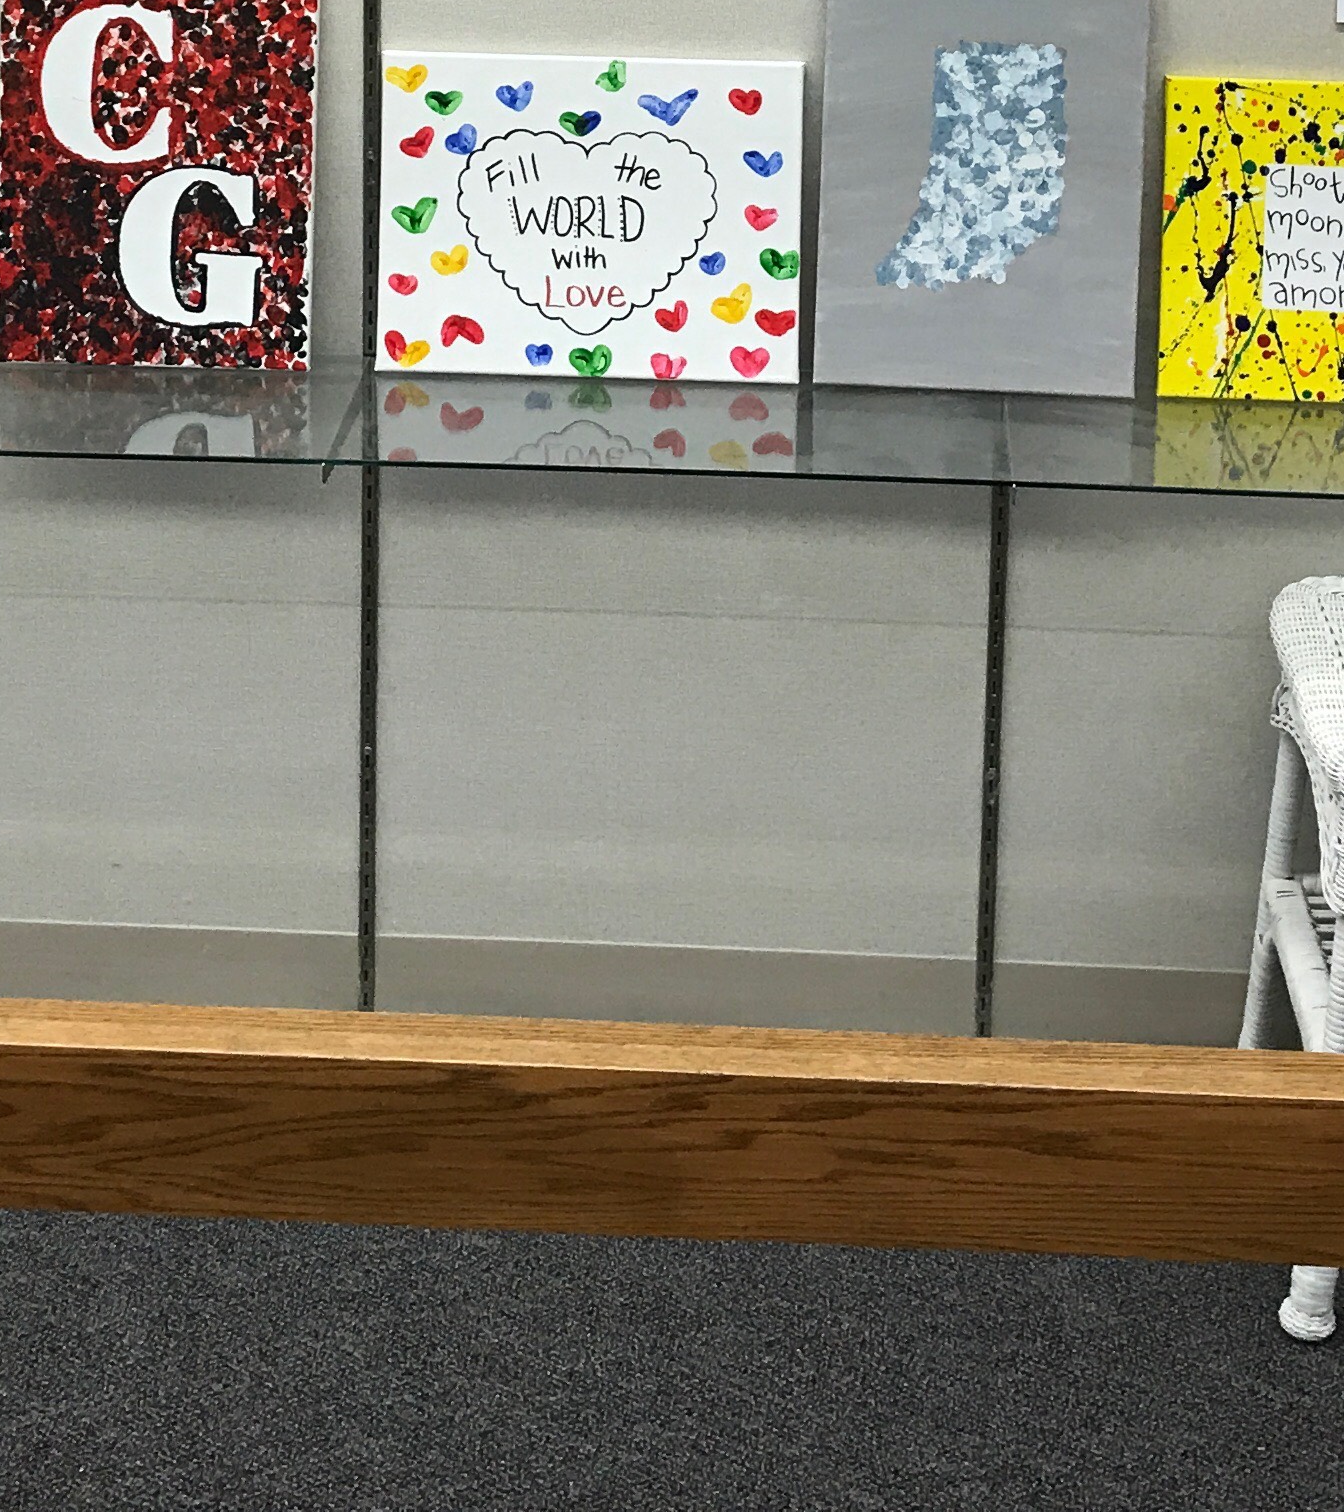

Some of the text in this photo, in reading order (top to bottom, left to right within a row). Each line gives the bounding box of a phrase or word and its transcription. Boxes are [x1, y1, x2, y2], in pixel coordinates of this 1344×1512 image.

[40, 3, 175, 165] C
[485, 152, 662, 192] Fill the
[507, 195, 645, 243] WORLD
[119, 167, 263, 327] G
[551, 244, 608, 270] with
[544, 274, 627, 309] Love
